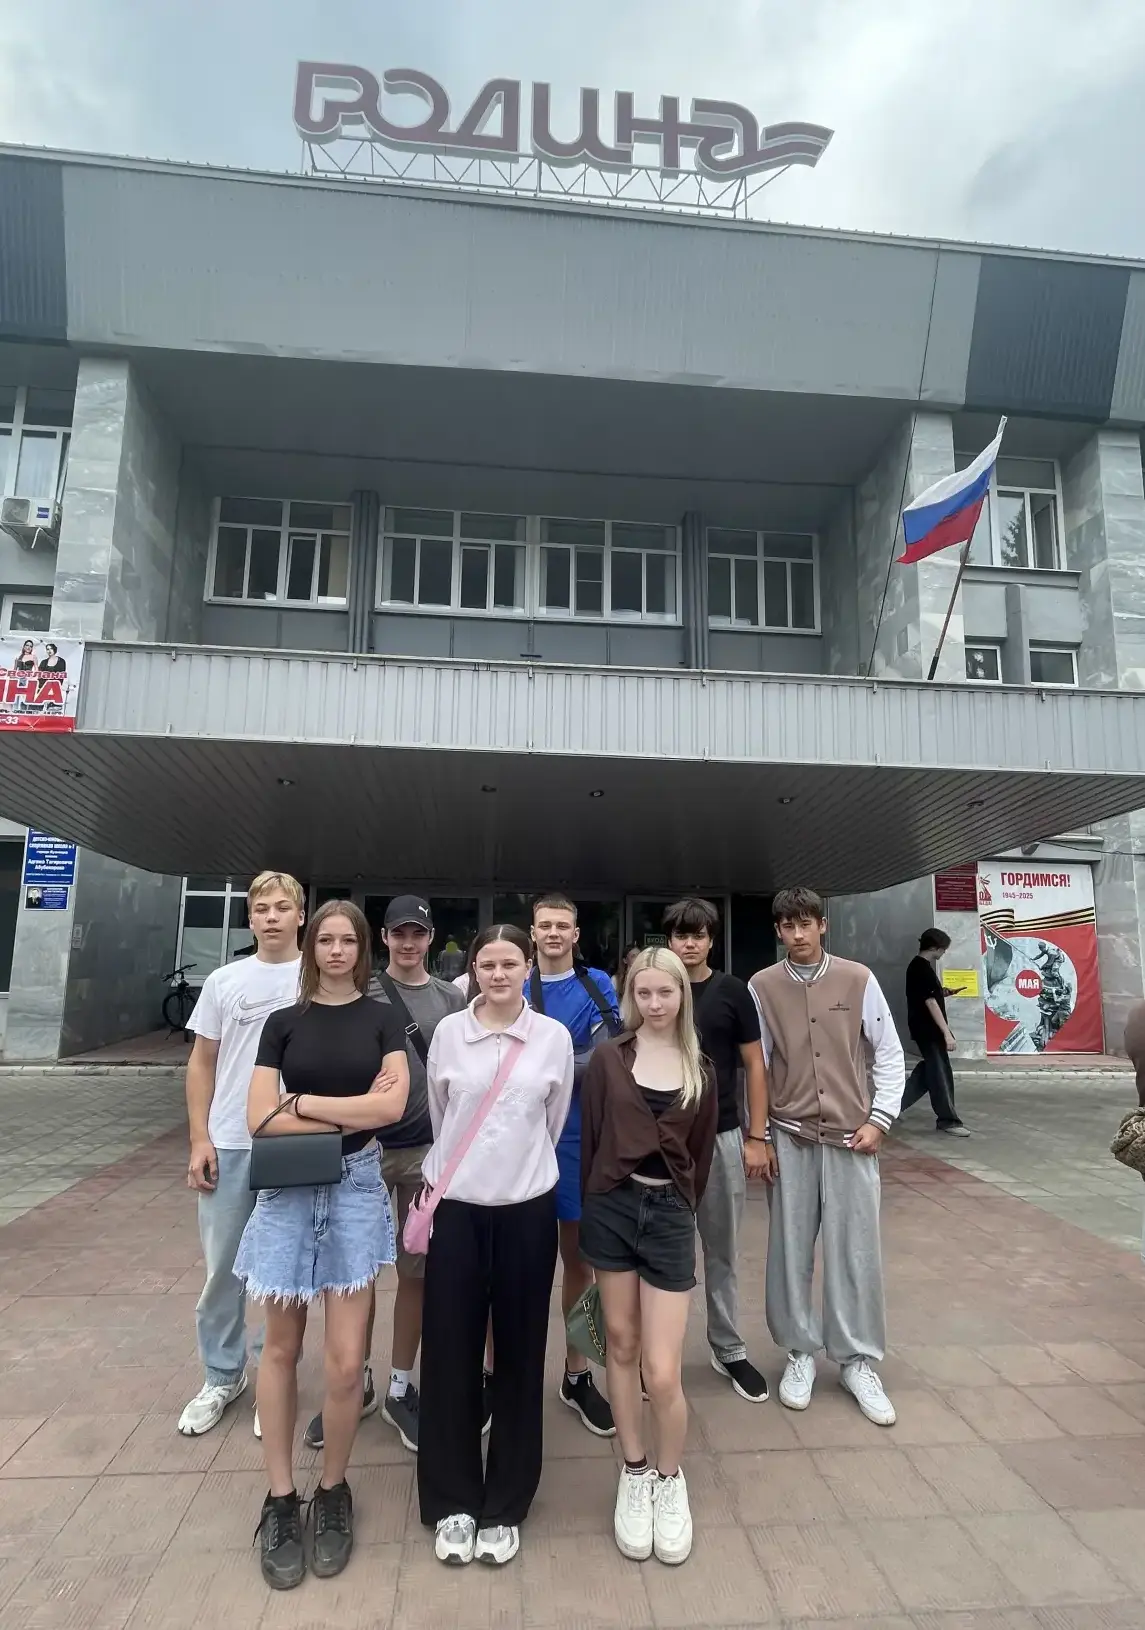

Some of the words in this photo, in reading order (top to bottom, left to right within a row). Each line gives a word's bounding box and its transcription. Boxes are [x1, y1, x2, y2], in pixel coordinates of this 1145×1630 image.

[293, 59, 835, 183] РОДИНА
[0, 679, 64, 704] НА
[1001, 872, 1071, 888] ГОРДИМСЯ!
[1018, 978, 1040, 989] МАЯ
